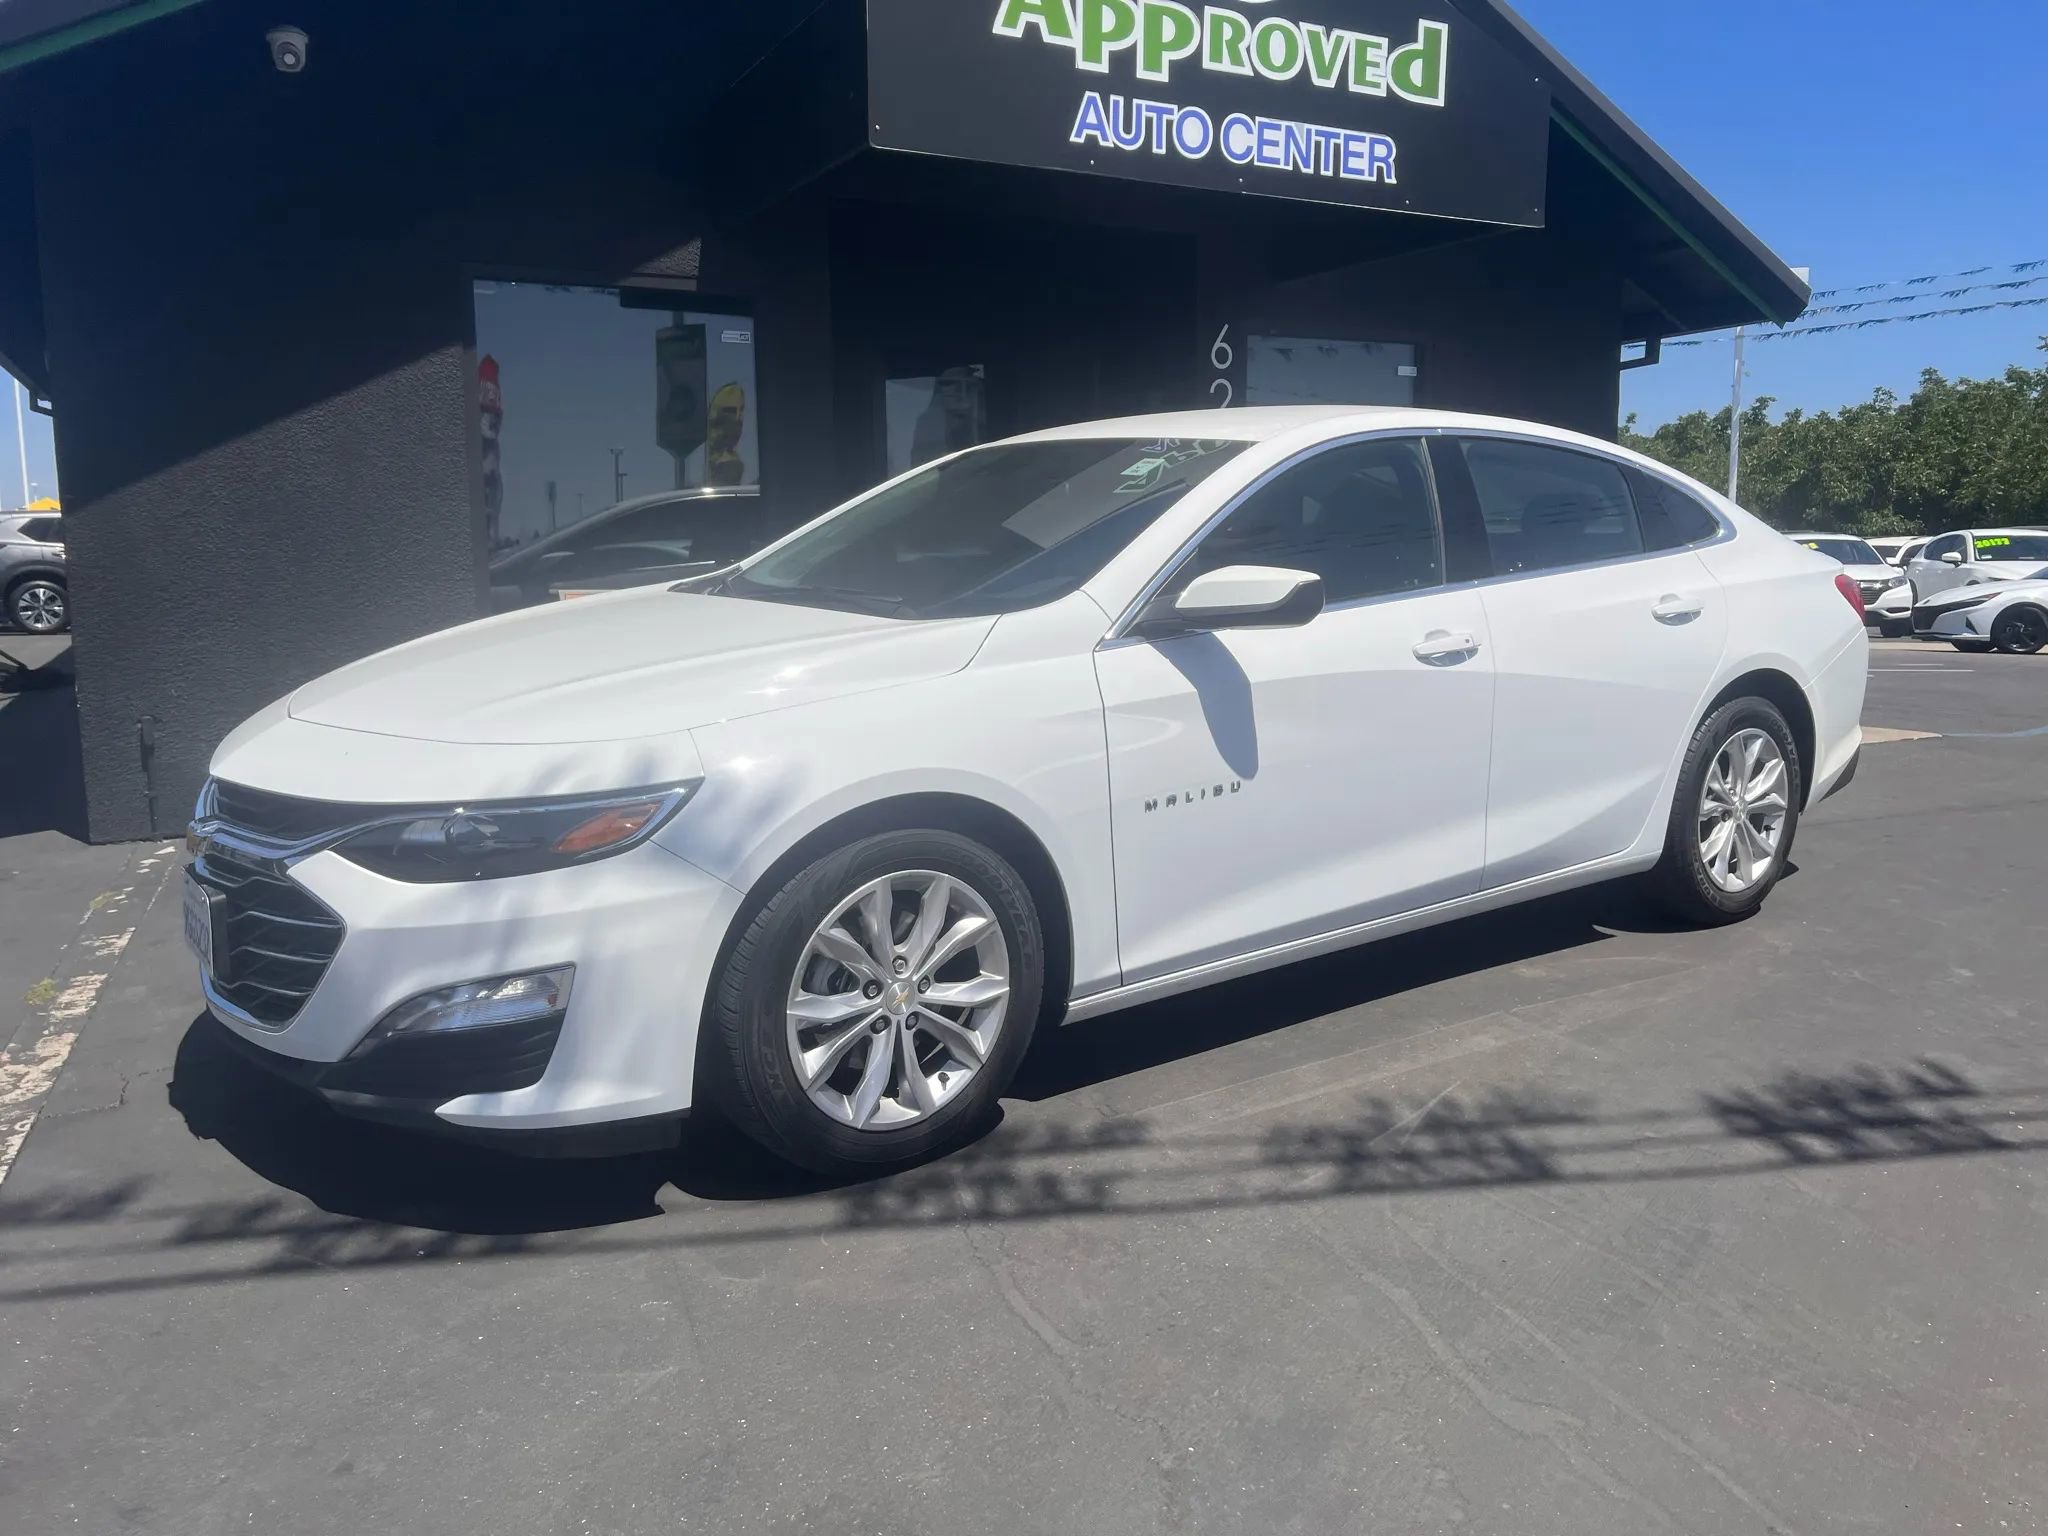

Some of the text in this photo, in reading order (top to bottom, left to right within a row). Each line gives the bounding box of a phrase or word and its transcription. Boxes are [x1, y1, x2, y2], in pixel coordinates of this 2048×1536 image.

[1070, 91, 1397, 184] AUTO CENTER
[1144, 780, 1241, 813] MALIBU
